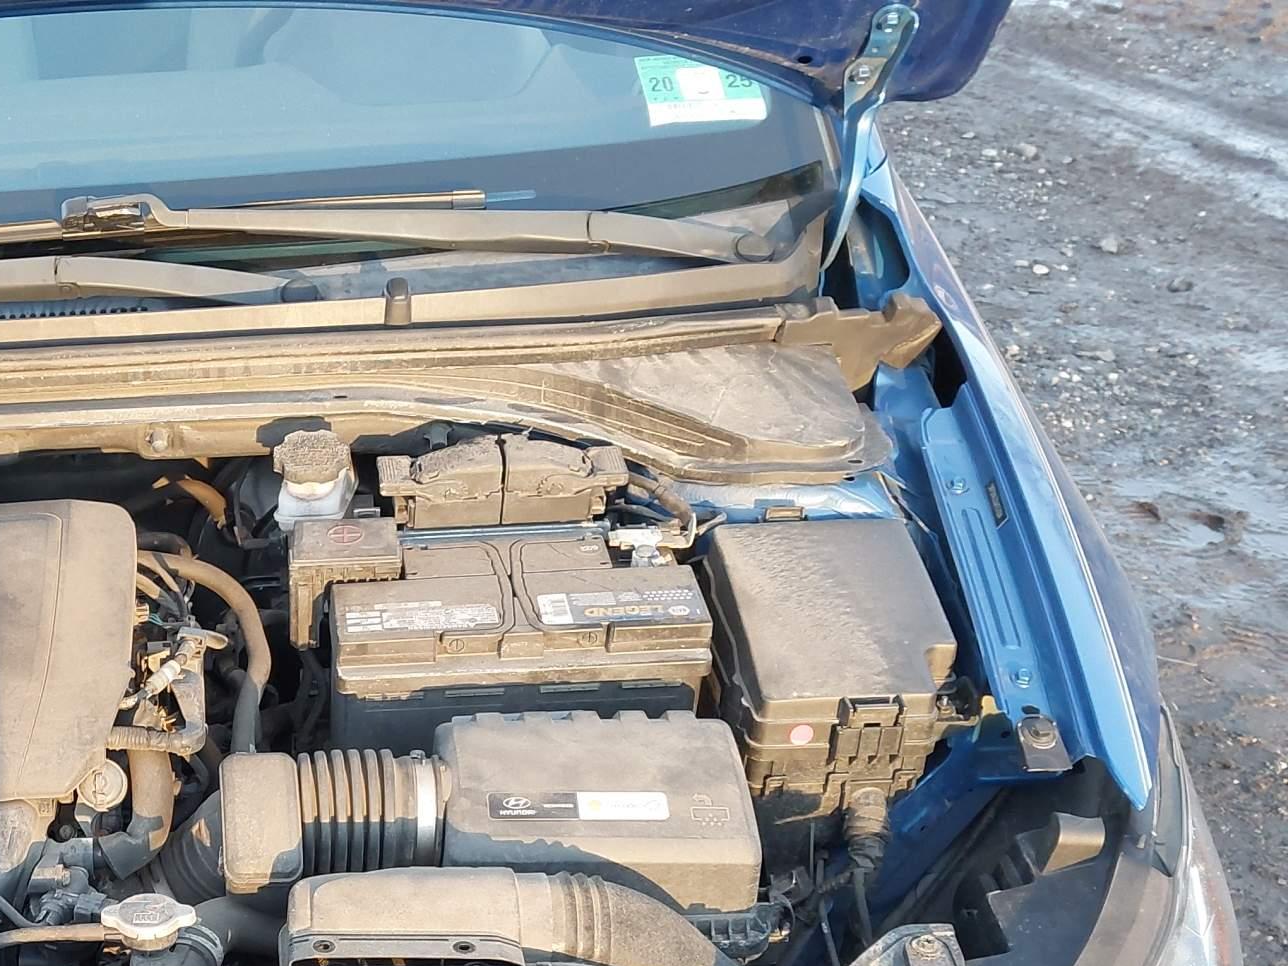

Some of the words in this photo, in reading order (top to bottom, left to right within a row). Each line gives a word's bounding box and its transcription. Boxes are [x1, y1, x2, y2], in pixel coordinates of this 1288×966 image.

[648, 76, 674, 93] 20
[725, 73, 753, 88] 25
[583, 604, 664, 618] LEGEND
[499, 809, 537, 817] HYUNDAI
